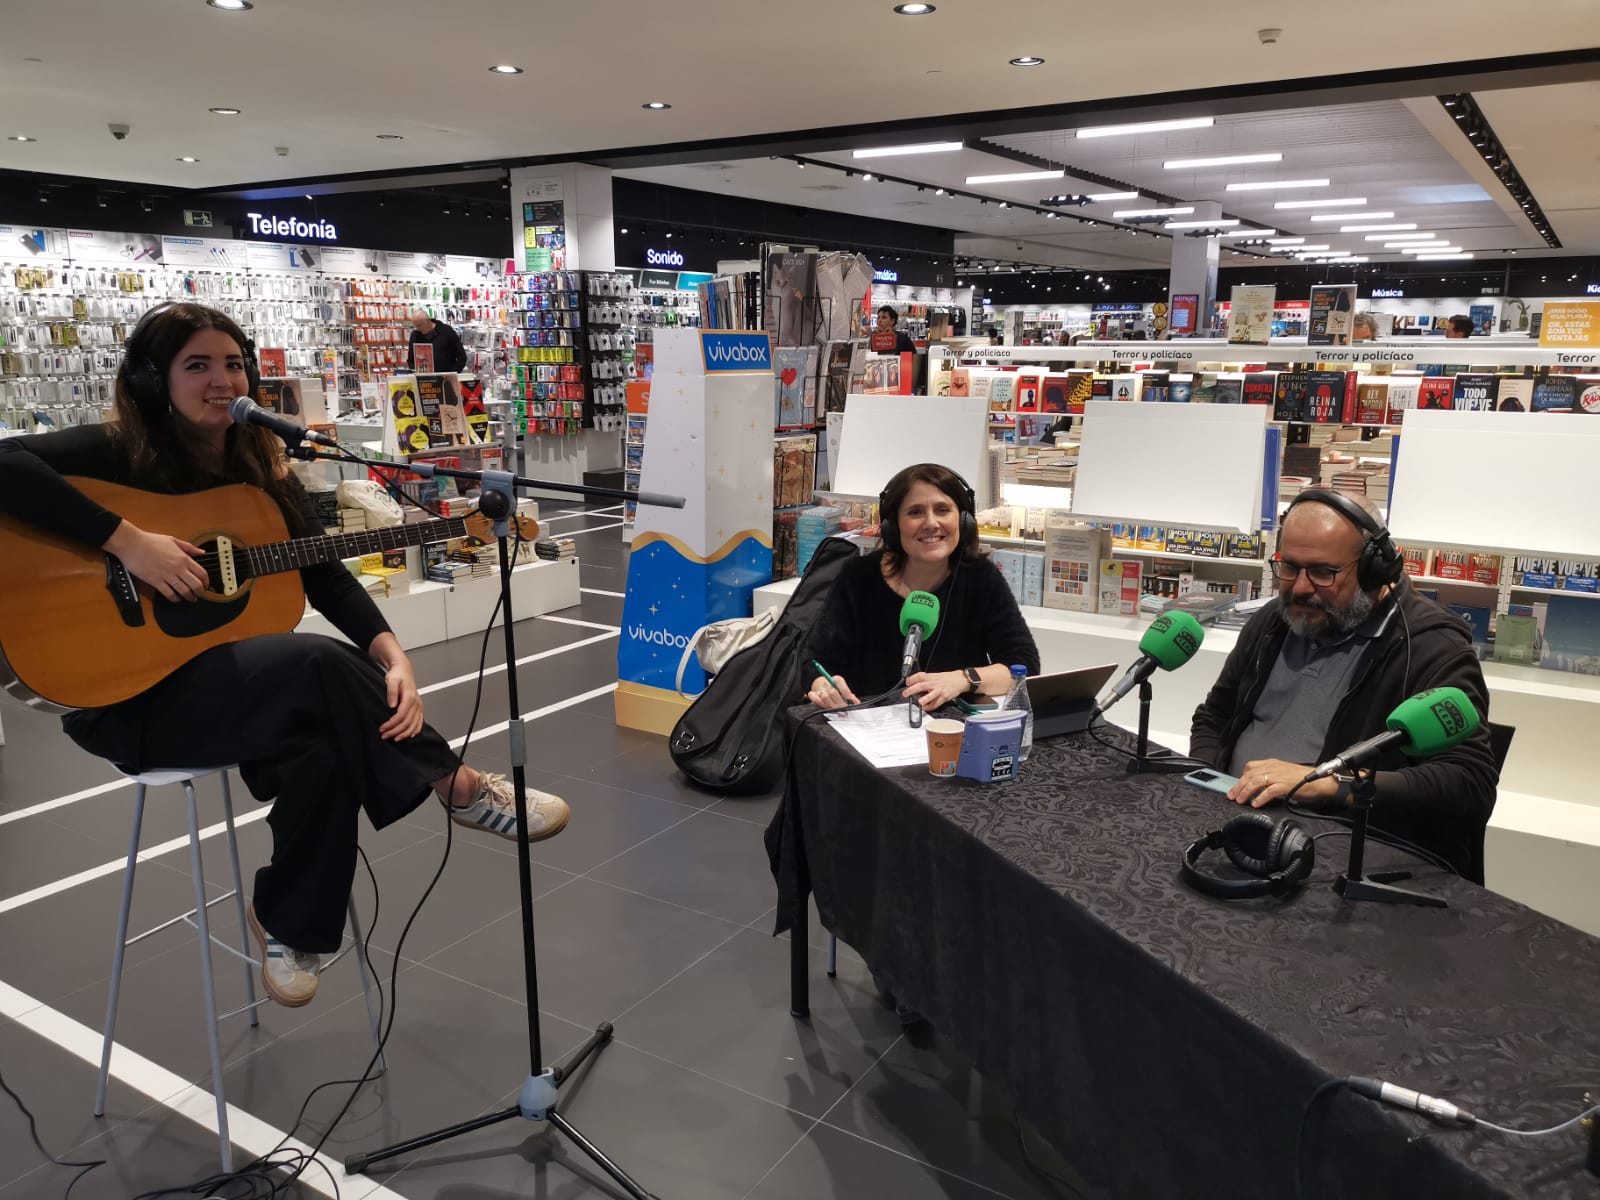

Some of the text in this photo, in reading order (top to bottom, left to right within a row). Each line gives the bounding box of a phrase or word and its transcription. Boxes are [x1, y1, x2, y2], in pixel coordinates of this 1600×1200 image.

[247, 213, 337, 239] Telefonía
[647, 249, 683, 266] Sonido
[1372, 289, 1403, 297] Música
[1546, 334, 1589, 342] VENTAJAS
[708, 341, 767, 362] vivabox
[942, 348, 1011, 358] Terror y policíaco
[1112, 350, 1193, 360] Terror y policíaco
[1315, 350, 1414, 362] Terror y policíaco
[1556, 352, 1596, 363] Terror
[1280, 382, 1308, 390] KING
[1545, 377, 1566, 385] JOHN
[1463, 388, 1487, 399] TODO
[1309, 396, 1336, 406] REINA
[1455, 399, 1493, 411] VUELVE
[1310, 406, 1334, 417] ROJA
[1443, 553, 1464, 564] NEGRA
[1516, 557, 1556, 574] VUELVE
[1558, 560, 1599, 577] VUELVE
